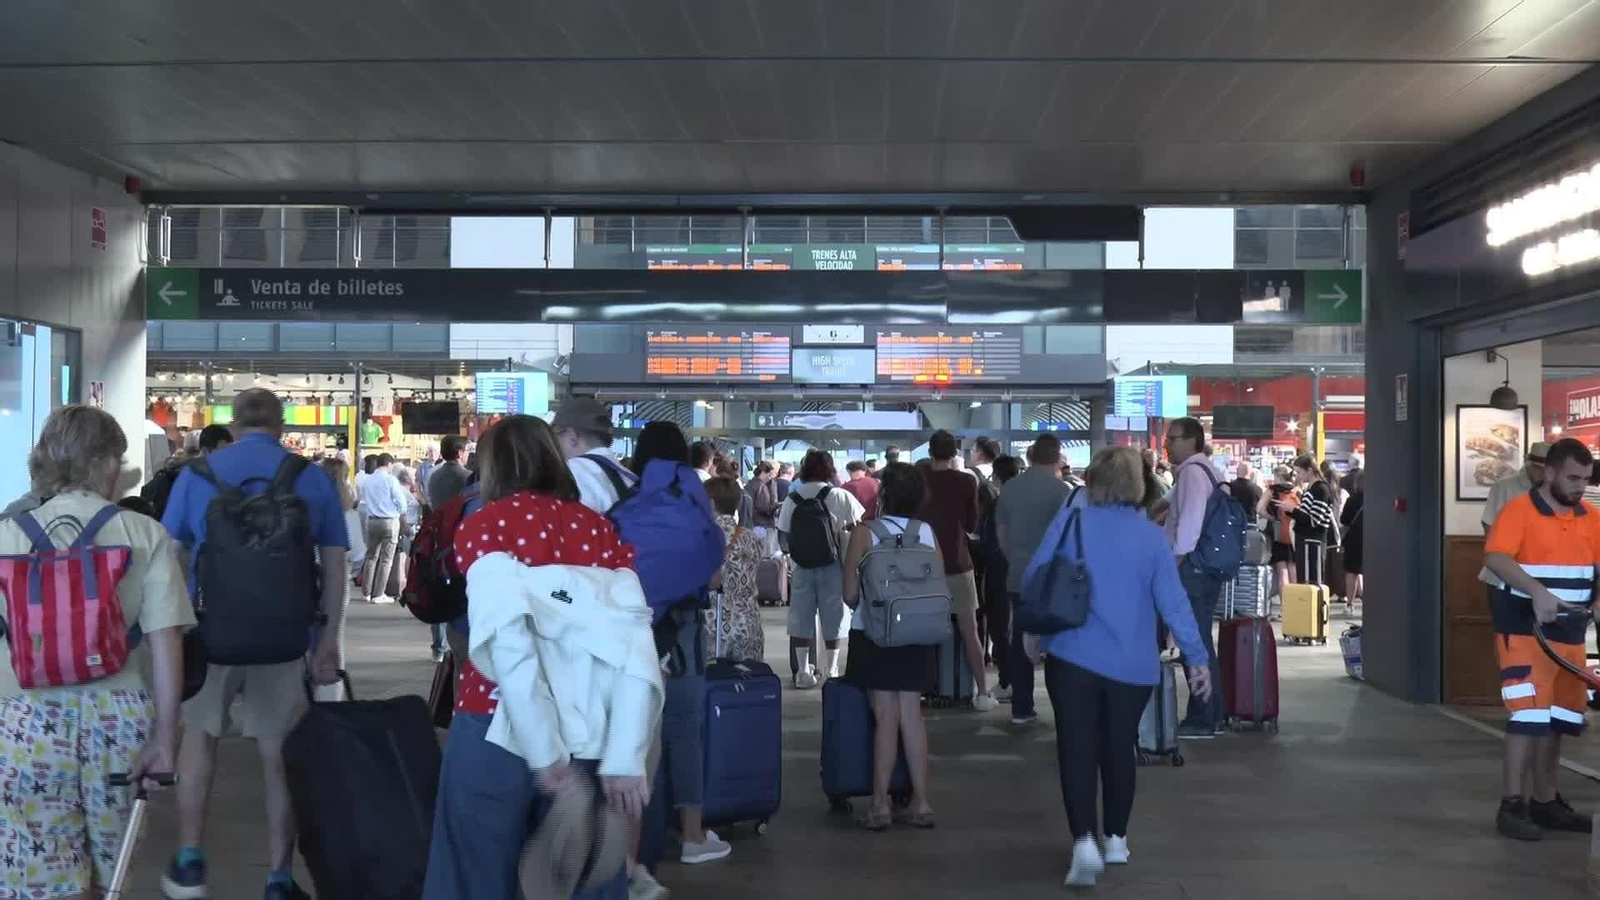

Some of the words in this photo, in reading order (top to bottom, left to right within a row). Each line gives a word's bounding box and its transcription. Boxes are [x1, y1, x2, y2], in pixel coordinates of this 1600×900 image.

[811, 250, 838, 260] TRENES
[840, 250, 857, 260] ALTA
[815, 261, 853, 270] VELOCIDAD
[251, 280, 301, 295] Venta
[309, 280, 331, 295] de
[338, 279, 404, 295] billetes
[251, 301, 287, 310] TICKETS
[291, 301, 314, 310] SALE
[812, 356, 831, 366] HIGH
